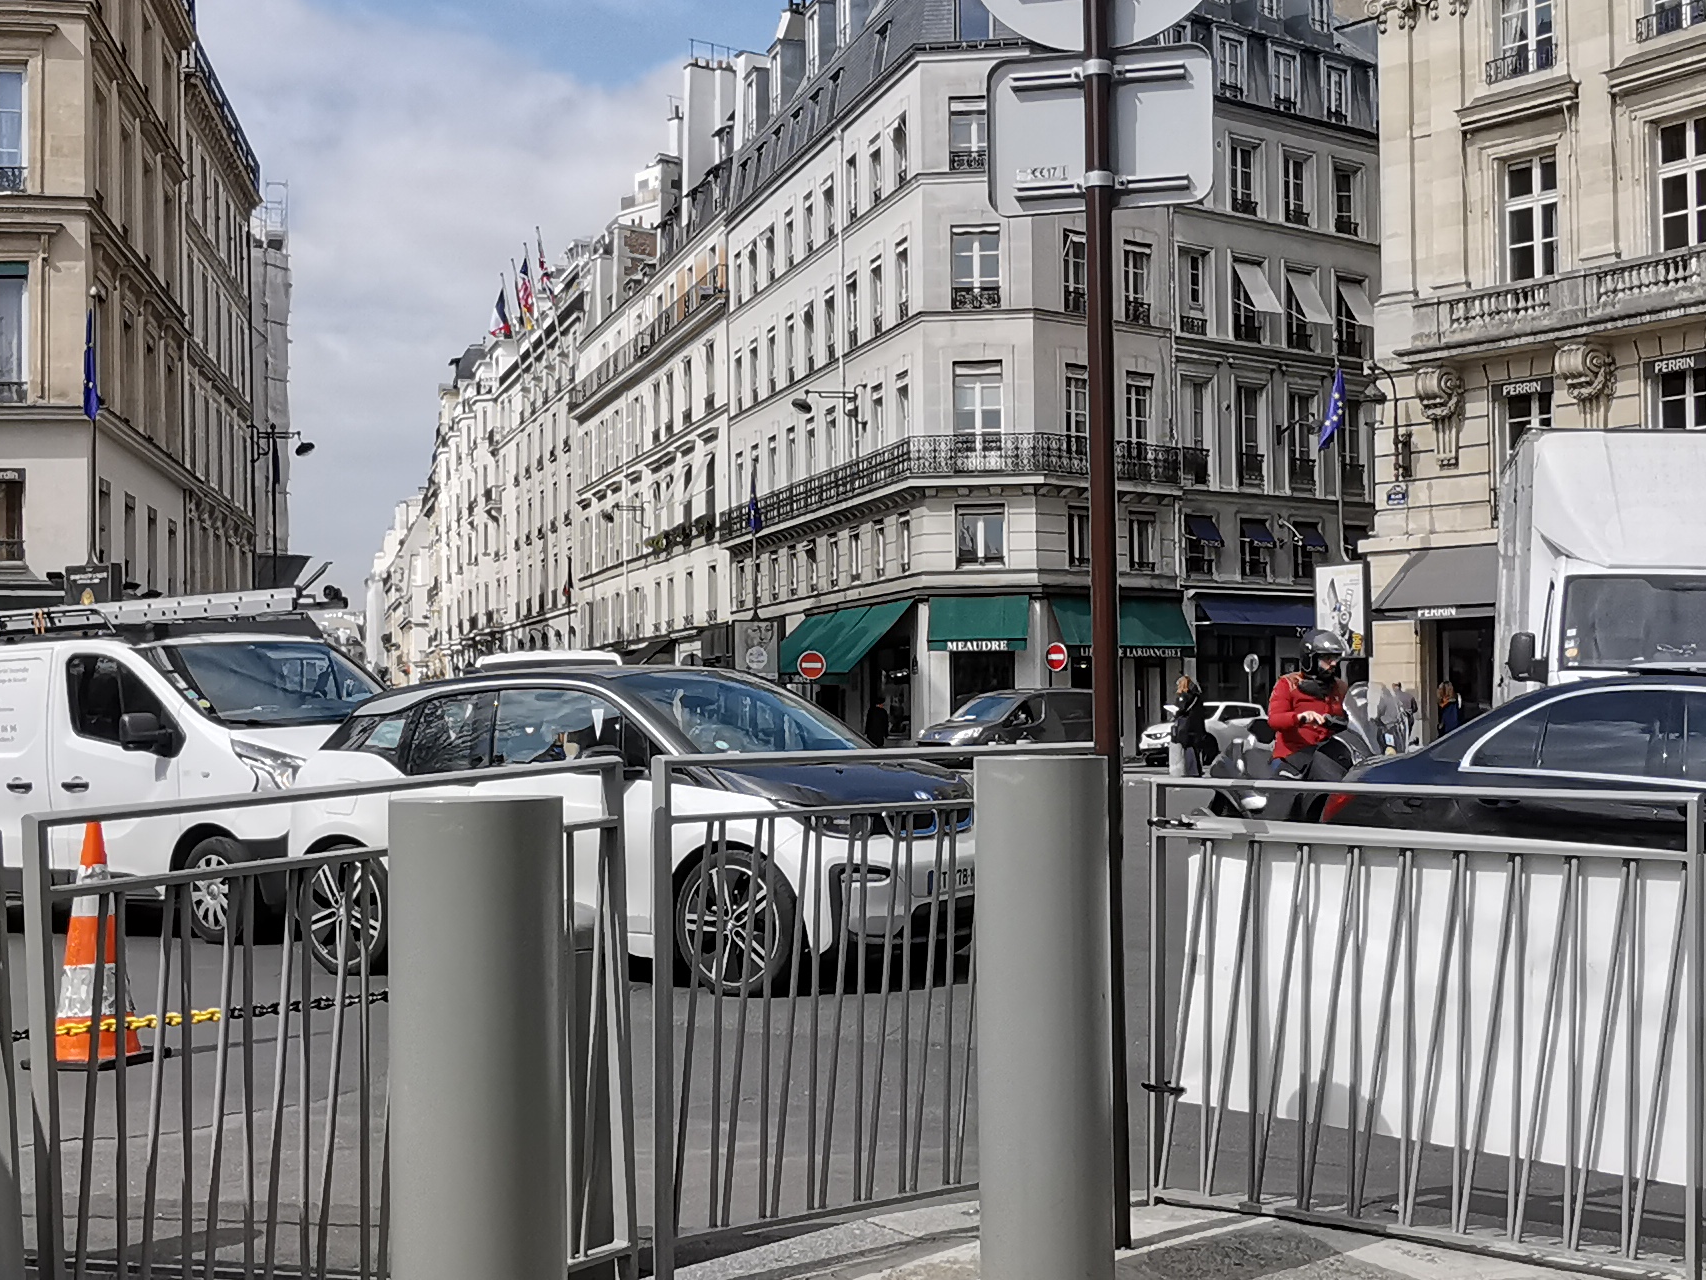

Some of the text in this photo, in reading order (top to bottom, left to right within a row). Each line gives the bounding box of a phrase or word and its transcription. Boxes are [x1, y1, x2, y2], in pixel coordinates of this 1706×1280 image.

[1654, 356, 1694, 373] PERRIN
[1502, 381, 1542, 396] PERRIN
[946, 640, 1008, 651] MEAUDRE
